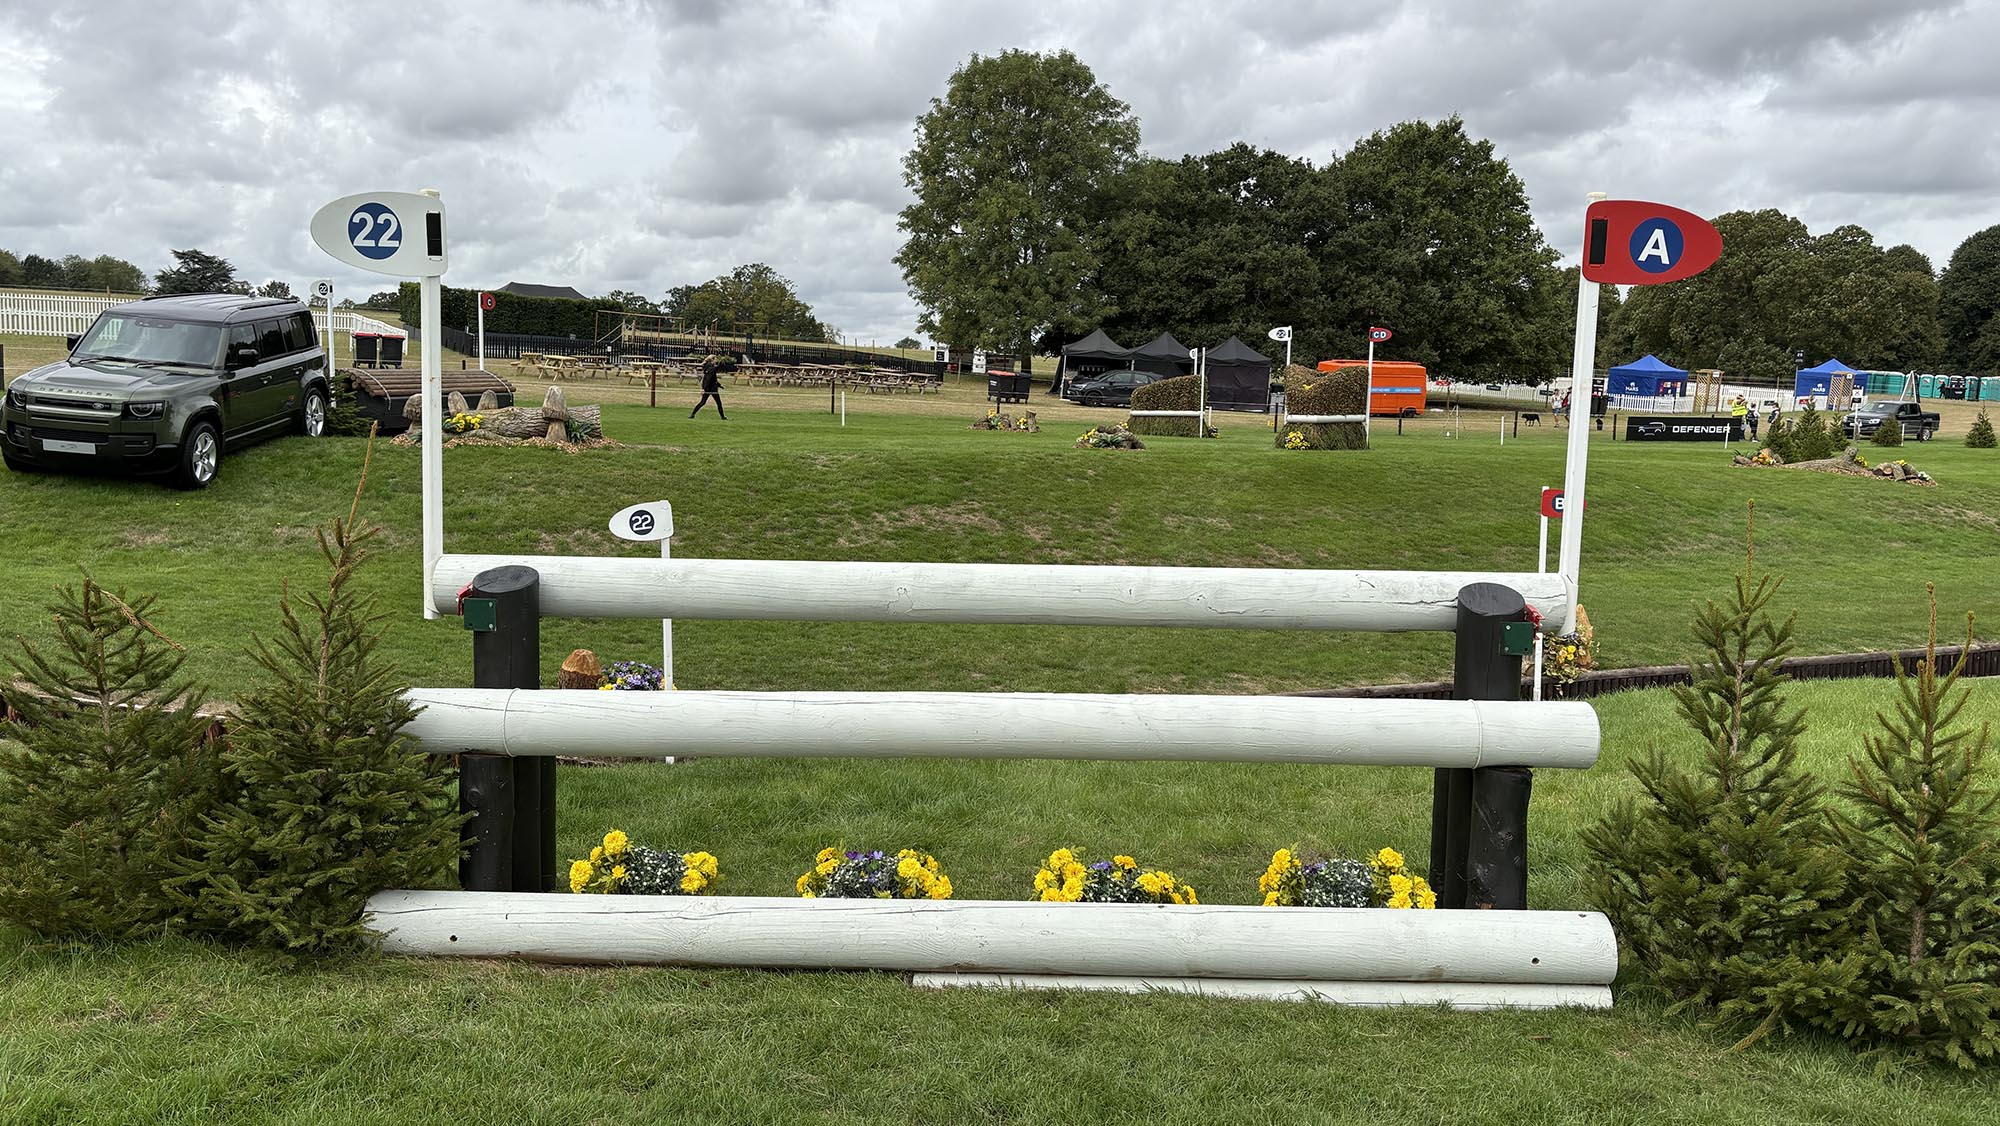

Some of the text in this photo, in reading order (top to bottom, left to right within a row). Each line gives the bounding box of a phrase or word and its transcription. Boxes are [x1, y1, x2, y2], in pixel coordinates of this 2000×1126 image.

[352, 211, 400, 248] 22
[1637, 228, 1670, 265] A
[319, 285, 328, 294] 22
[487, 298, 492, 306] C
[1373, 331, 1387, 339] CD
[1672, 425, 1731, 434] DEFENDER
[1555, 497, 1564, 510] B
[631, 514, 653, 531] 22
